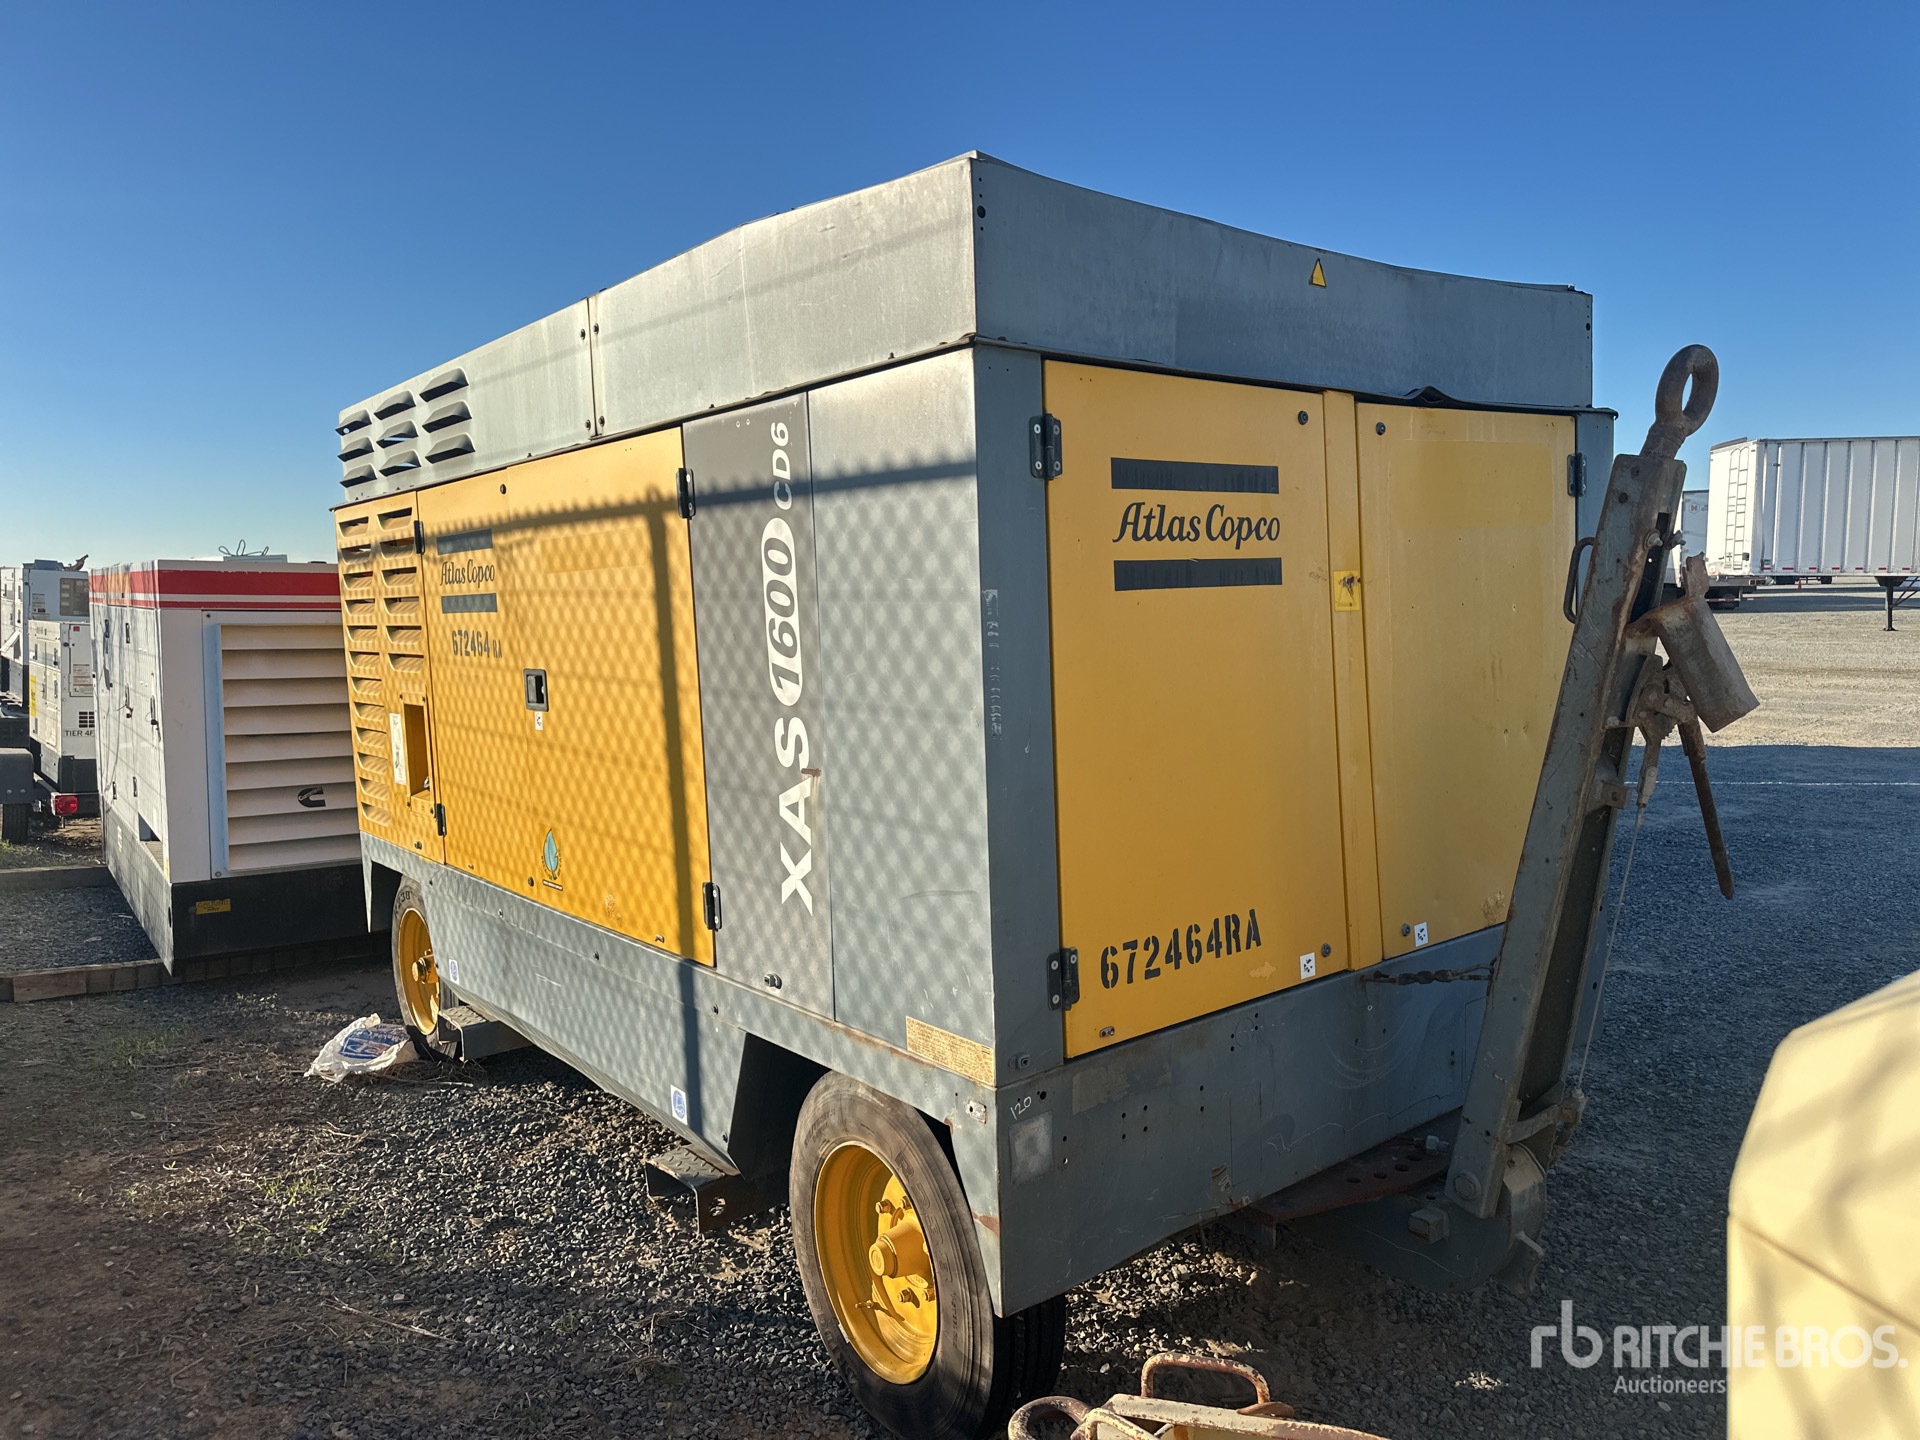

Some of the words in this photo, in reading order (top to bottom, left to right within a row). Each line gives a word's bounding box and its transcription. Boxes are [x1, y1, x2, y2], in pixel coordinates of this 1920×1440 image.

[770, 421, 793, 510] CD6
[1112, 502, 1200, 543] Atlas
[1205, 503, 1280, 549] Copco
[440, 561, 466, 586] Atlas
[467, 559, 495, 588] Copco
[452, 630, 490, 658] 672464
[765, 537, 800, 690] 1600
[774, 716, 813, 917] XAS
[1100, 909, 1262, 989] 672464RA
[1010, 1096, 1032, 1120] 120
